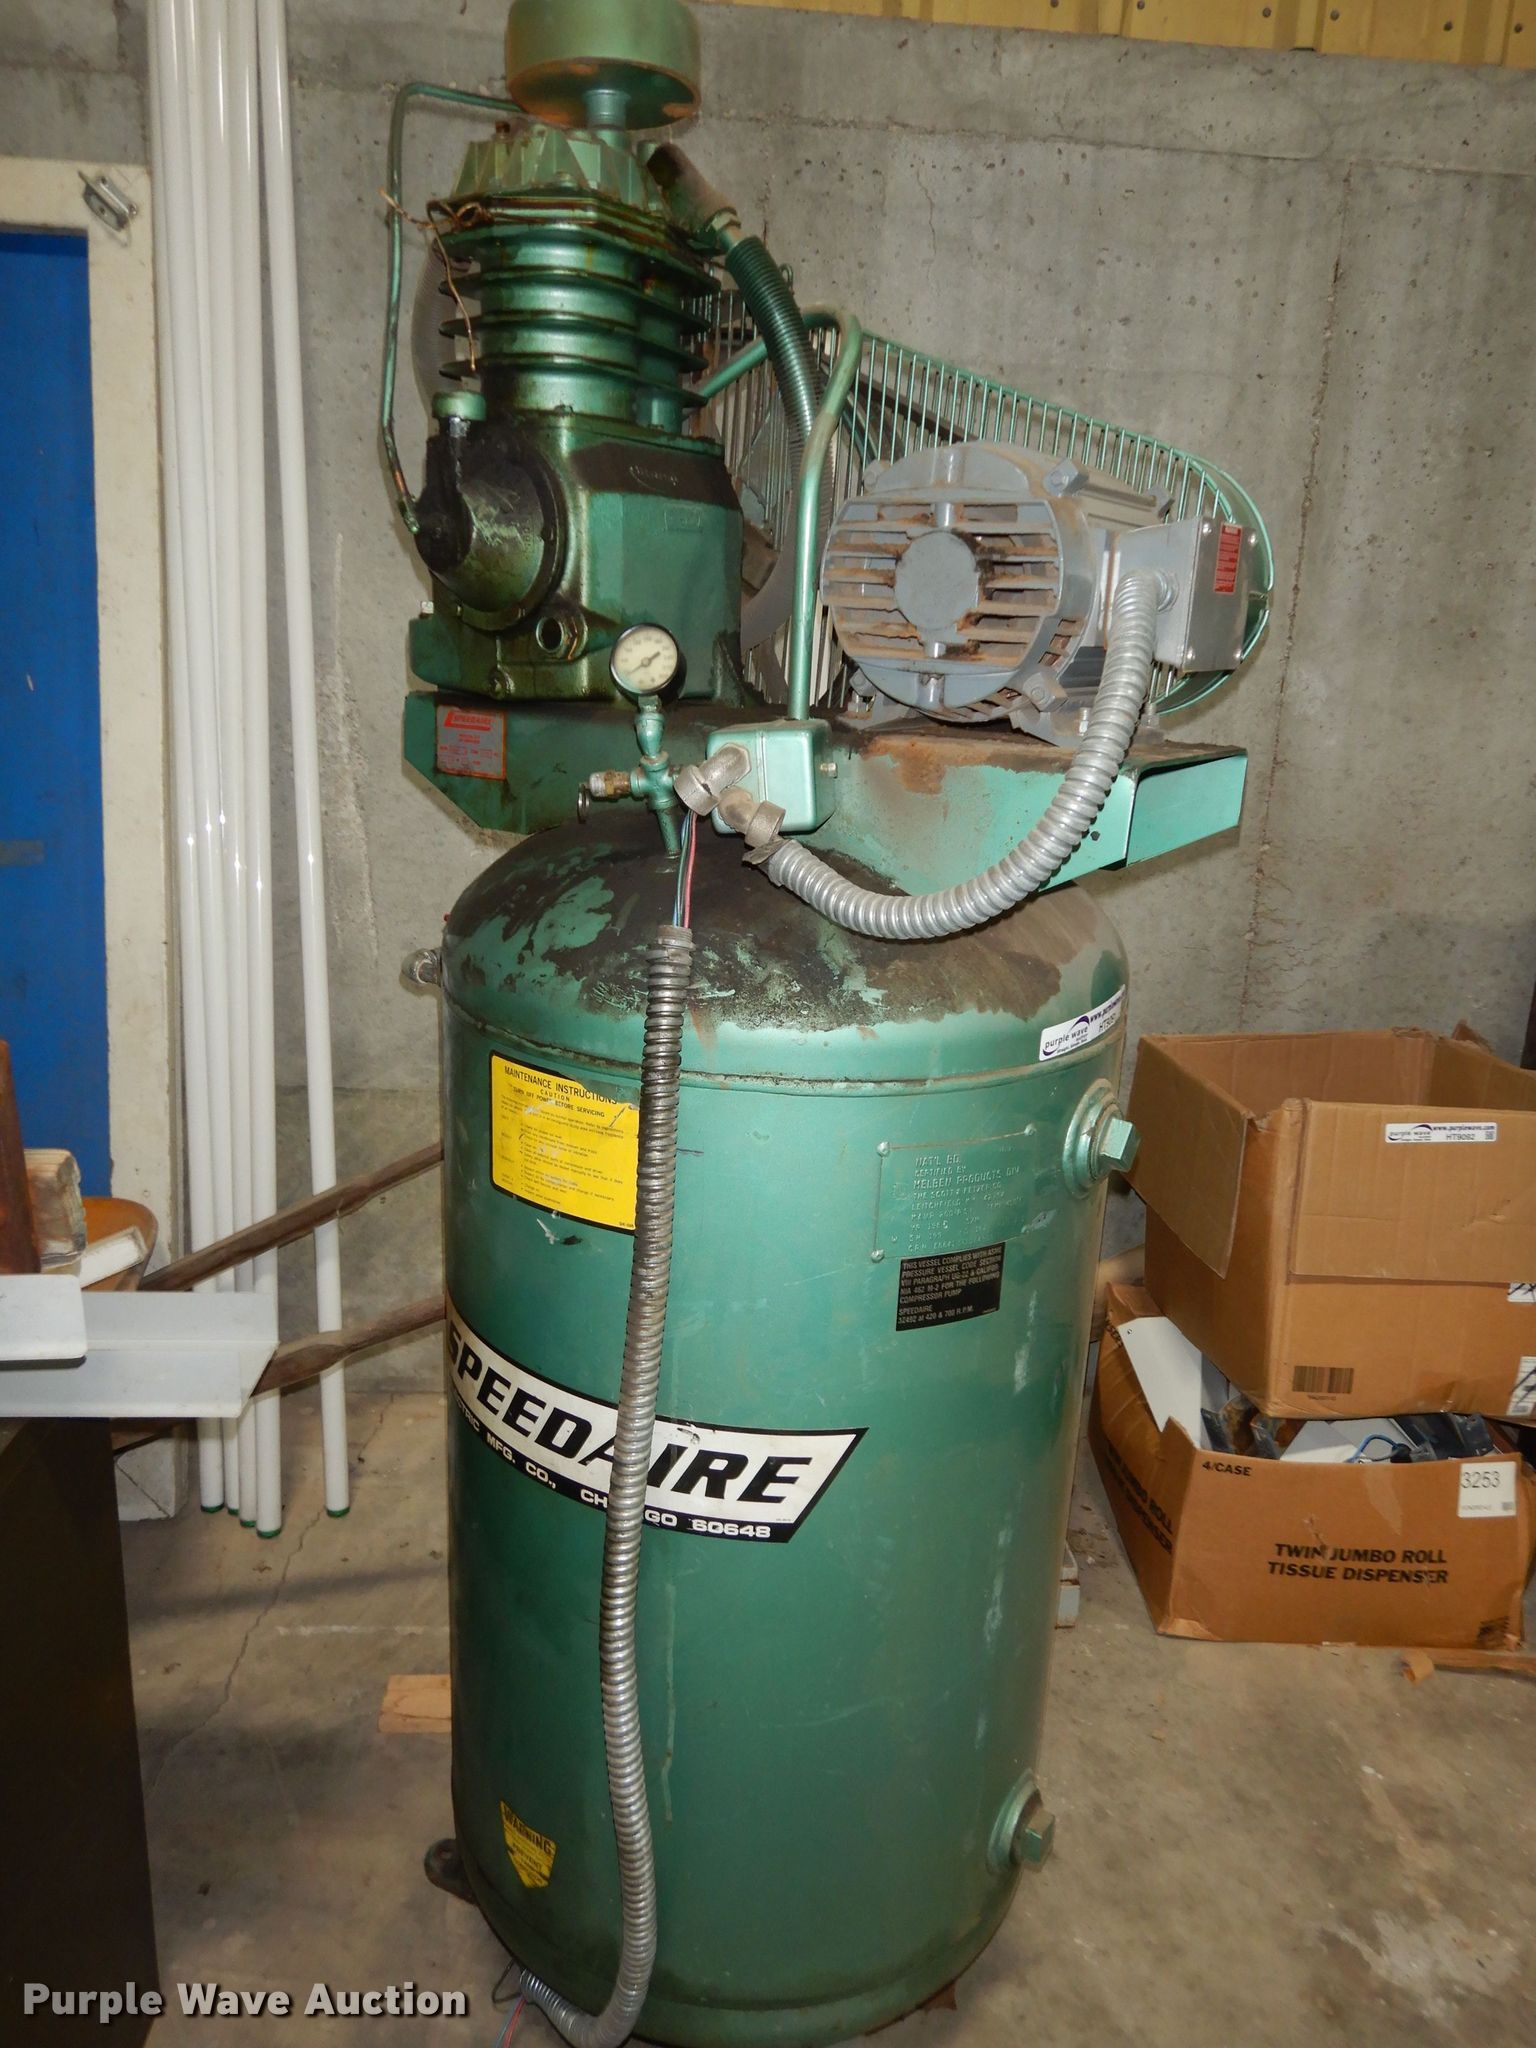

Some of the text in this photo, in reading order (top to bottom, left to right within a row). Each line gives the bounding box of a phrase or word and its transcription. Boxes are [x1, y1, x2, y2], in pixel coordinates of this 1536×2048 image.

[1045, 1034, 1069, 1049] purple
[1071, 1026, 1088, 1039] wave
[504, 1066, 617, 1105] MAINTENANCE INSTRUCTIONS
[540, 1089, 570, 1102] CAUTION
[577, 1106, 605, 1118] SERVICING
[902, 1268, 935, 1279] PRESSURE
[899, 1305, 933, 1316] SPEEDAIRE
[486, 1433, 516, 1464] MFG.
[525, 1461, 556, 1489] CO.,
[580, 1489, 678, 1528] CHGO
[692, 1518, 771, 1539] 60648
[1461, 1471, 1500, 1489] 3253
[1275, 1543, 1448, 1564] TWIN JUMBO ROLL
[1268, 1561, 1448, 1584] TISSUE DISPENSER
